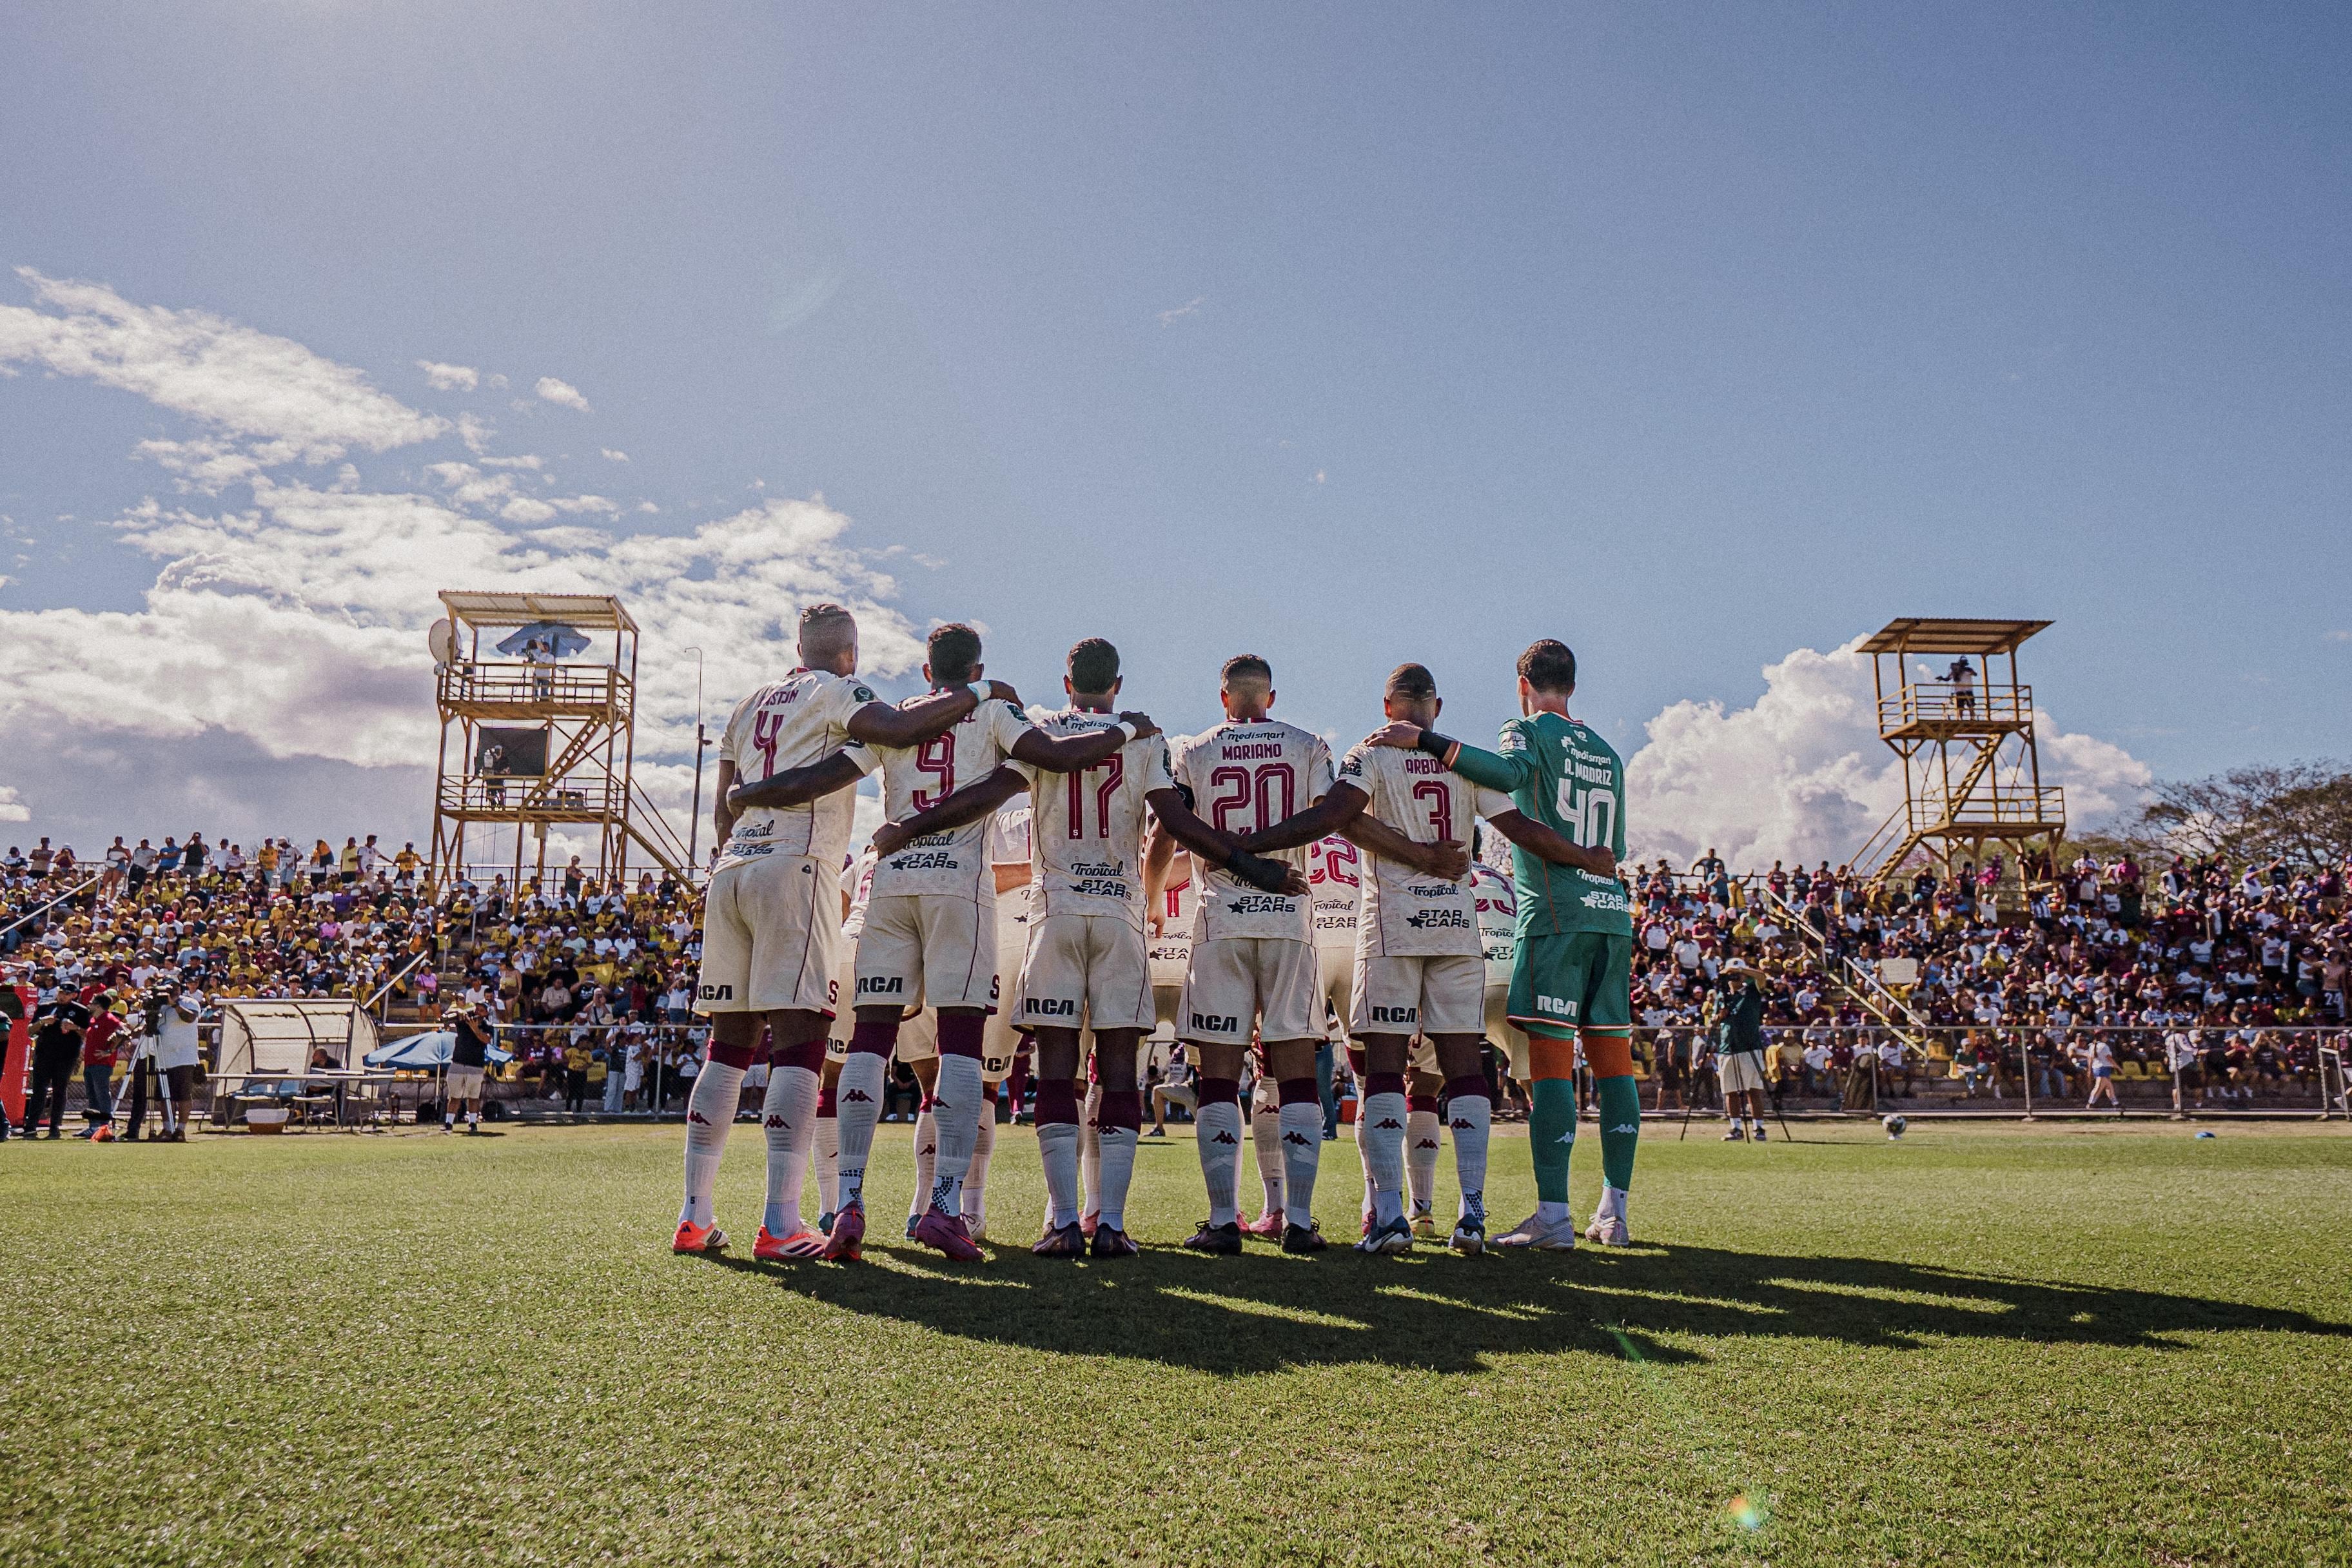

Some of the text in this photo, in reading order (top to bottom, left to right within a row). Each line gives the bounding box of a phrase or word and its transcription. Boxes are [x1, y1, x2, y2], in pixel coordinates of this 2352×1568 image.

[1071, 720, 1120, 730] medism
[753, 710, 785, 780] 4
[1228, 731, 1286, 742] medismart
[1222, 744, 1282, 760] MARIANO
[1571, 747, 1611, 765] medismart
[912, 729, 955, 814] 9
[1564, 758, 1611, 787] A. MADRIZ
[1068, 753, 1123, 839] 17
[1211, 763, 1295, 836] 20
[1413, 780, 1452, 845] 3
[1556, 778, 1616, 850] 40
[903, 830, 954, 849] ropical
[901, 852, 949, 861] STAR
[906, 860, 958, 869] CARS
[1071, 860, 1124, 877] Tropical
[1576, 868, 1614, 886] Tropical
[1081, 879, 1126, 890] STAR
[1408, 883, 1458, 898] Tropical
[1088, 888, 1132, 901] CARS
[1239, 896, 1286, 905] STAR
[1590, 890, 1623, 903] STAR
[1247, 904, 1296, 913] CARS
[1597, 899, 1629, 912] CARS
[1418, 910, 1462, 919] STAR
[1426, 918, 1470, 928] CARS
[1151, 931, 1192, 940] ropica
[1478, 927, 1514, 938] Tropic
[828, 979, 839, 1005] S
[858, 976, 903, 994] RCA
[990, 974, 1000, 1000] S
[1026, 998, 1074, 1015] RCA
[1372, 1006, 1416, 1023] RCA
[1537, 995, 1578, 1017] RCA
[1192, 1012, 1237, 1032] RCA
[826, 1037, 852, 1054] RC
